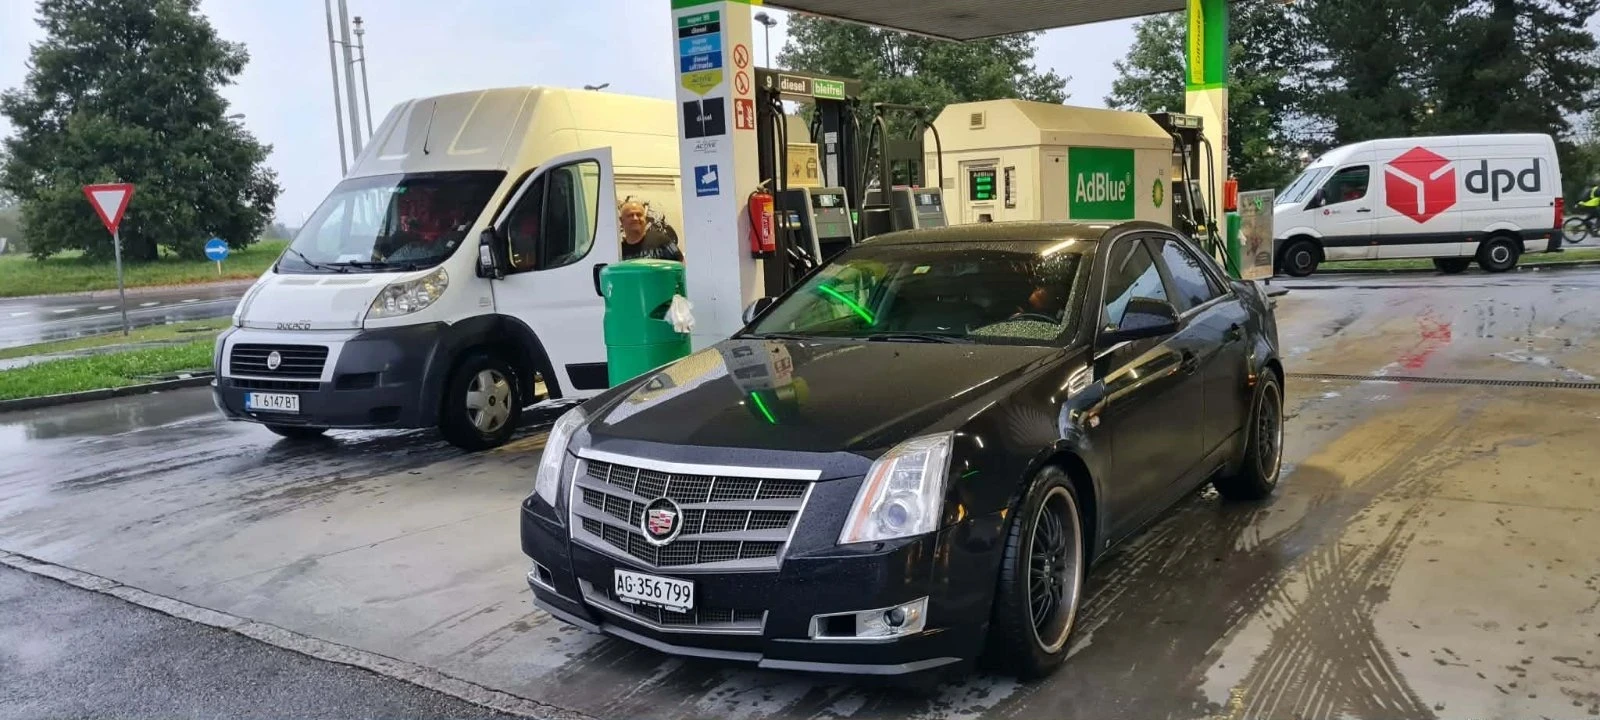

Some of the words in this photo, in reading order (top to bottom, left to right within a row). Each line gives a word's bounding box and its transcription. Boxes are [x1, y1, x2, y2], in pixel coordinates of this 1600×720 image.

[691, 25, 707, 34] diesel
[693, 54, 709, 63] diesel
[766, 75, 772, 88] 9
[781, 78, 805, 92] diesel
[815, 83, 842, 97] bleifrei
[1464, 157, 1541, 202] dpd
